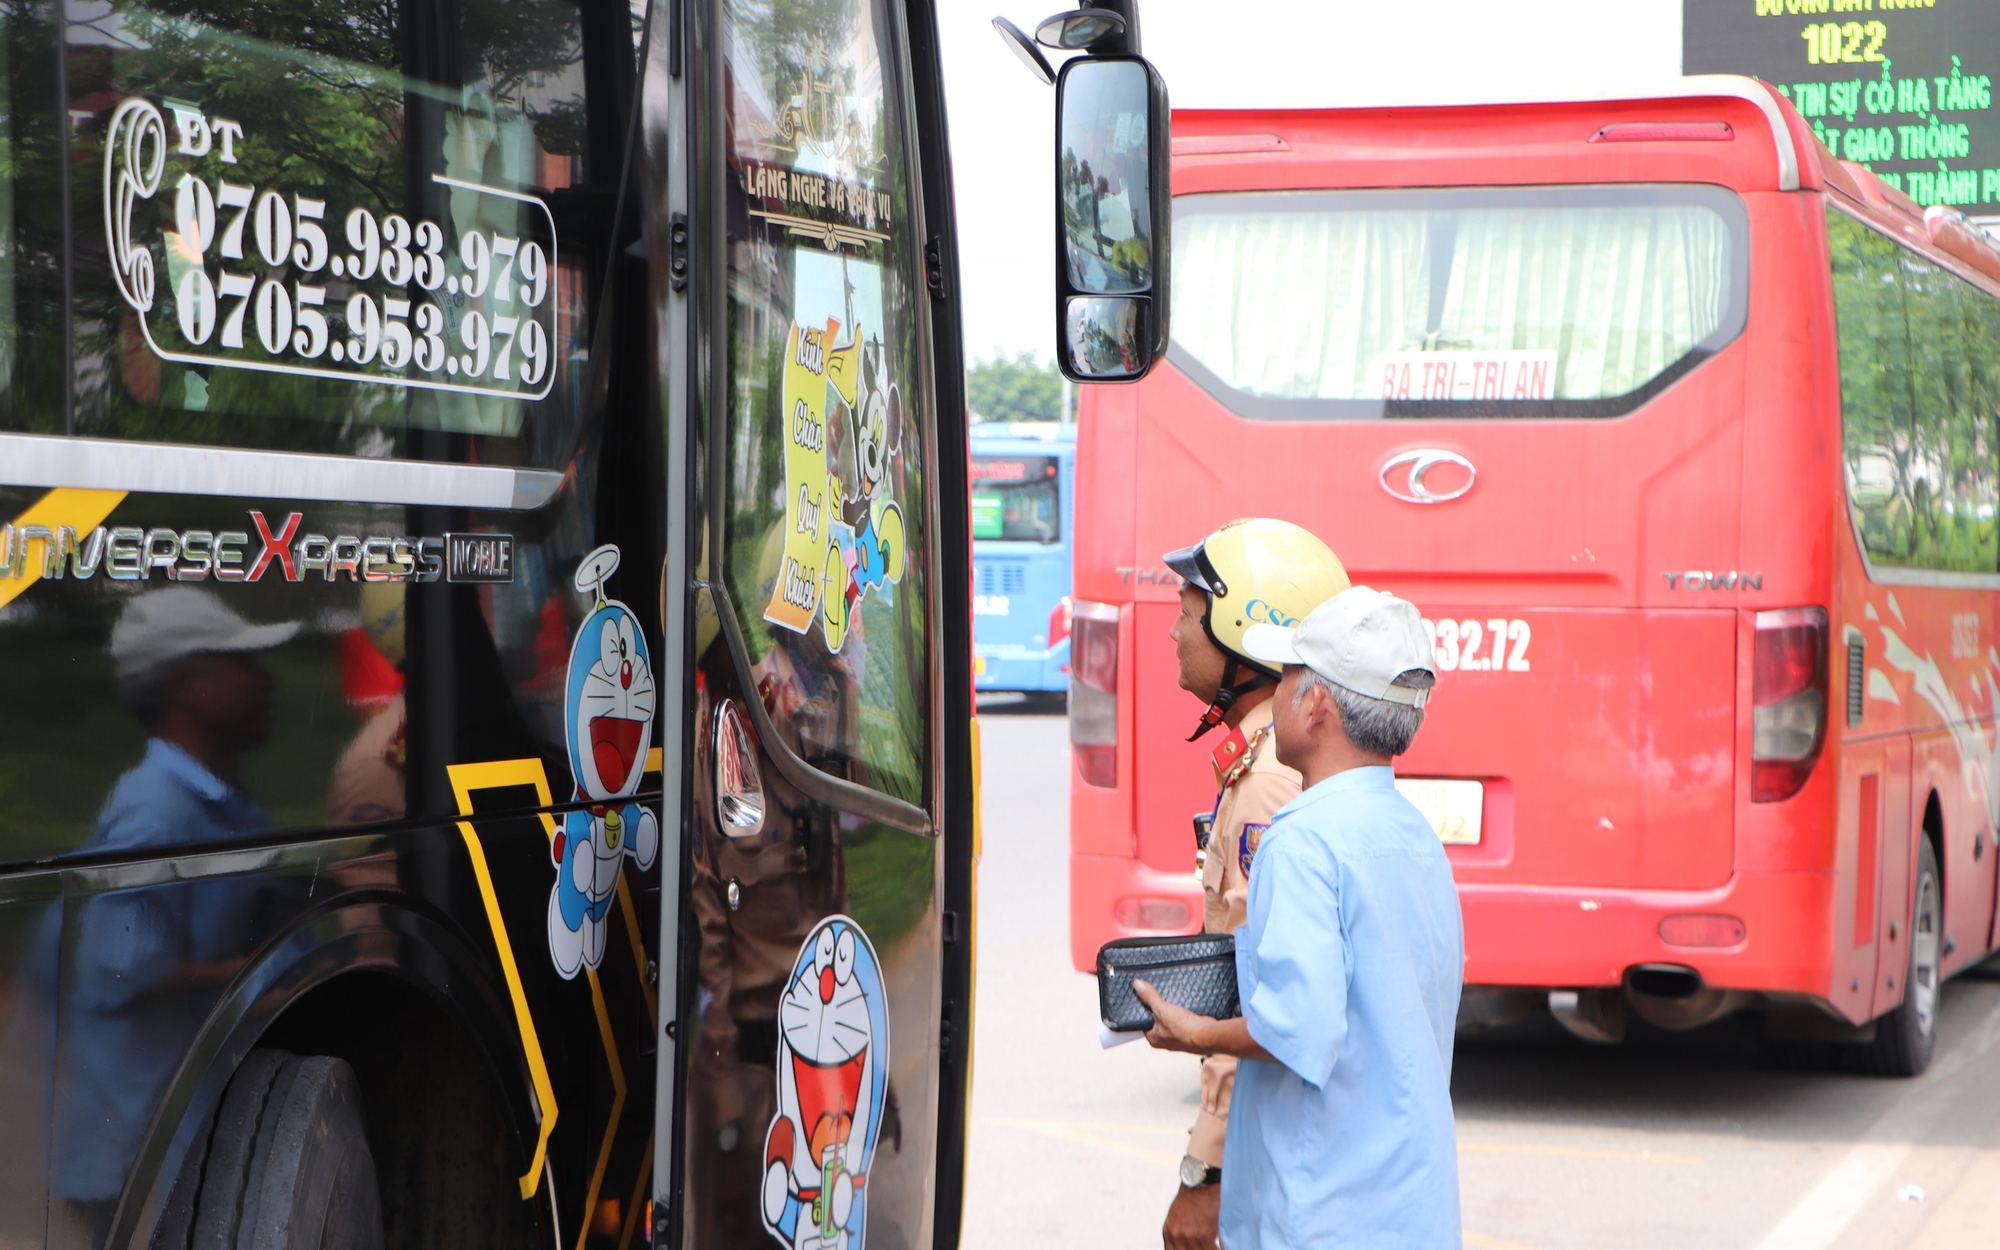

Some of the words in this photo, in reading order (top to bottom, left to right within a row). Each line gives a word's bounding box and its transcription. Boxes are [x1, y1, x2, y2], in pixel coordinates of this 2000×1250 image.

[1801, 20, 1887, 64] 1022
[1793, 82, 1827, 117] TIN
[1829, 77, 1862, 122] SỰ
[1898, 77, 1931, 119] HẠ
[1934, 54, 1991, 110] TẦNG
[177, 112, 244, 164] ĐT
[1843, 127, 1895, 162] GIAO
[1898, 113, 1970, 160] THÔNG
[791, 173, 826, 208] NGHE
[1906, 160, 1978, 206] THÀNH
[175, 177, 548, 308] 0705.933.979
[176, 268, 548, 386] 0705.953.979
[795, 327, 824, 376] Kính
[1381, 362, 1411, 400] BA
[1513, 360, 1549, 400] AN
[792, 397, 823, 454] Chào
[797, 482, 822, 544] Quý
[453, 539, 510, 576] NOBLE
[1115, 566, 1180, 586] THA
[1662, 569, 1763, 592] TOWN
[783, 556, 815, 612] Khách
